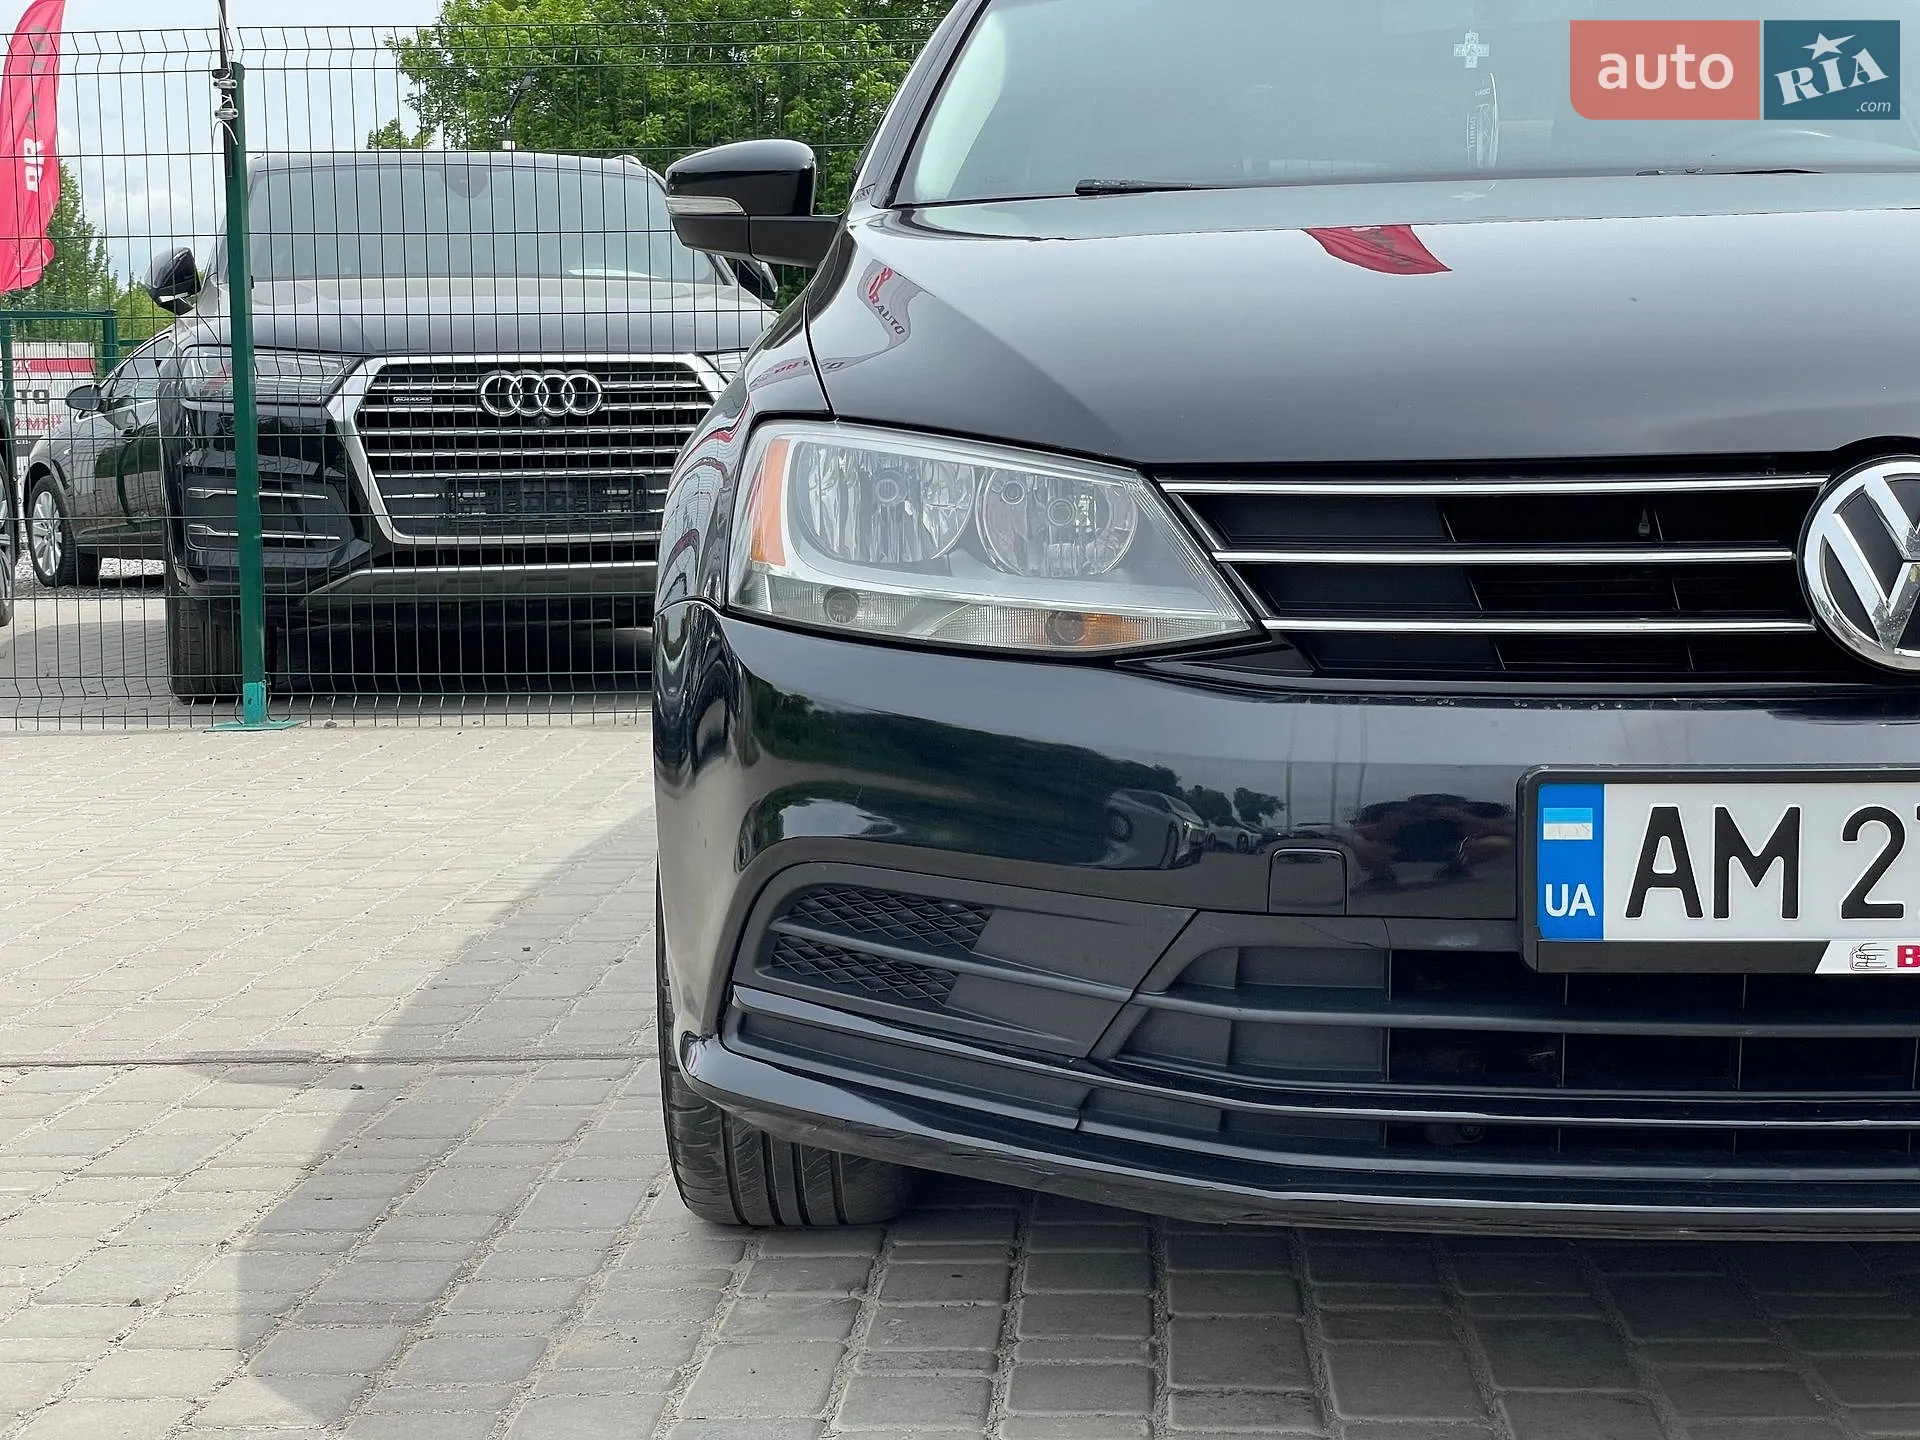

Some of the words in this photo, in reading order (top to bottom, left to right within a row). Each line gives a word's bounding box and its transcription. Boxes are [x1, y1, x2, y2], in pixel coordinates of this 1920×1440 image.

[1625, 806, 1800, 919] AM
[1841, 805, 1920, 919] 2
[1545, 883, 1597, 918] UA
